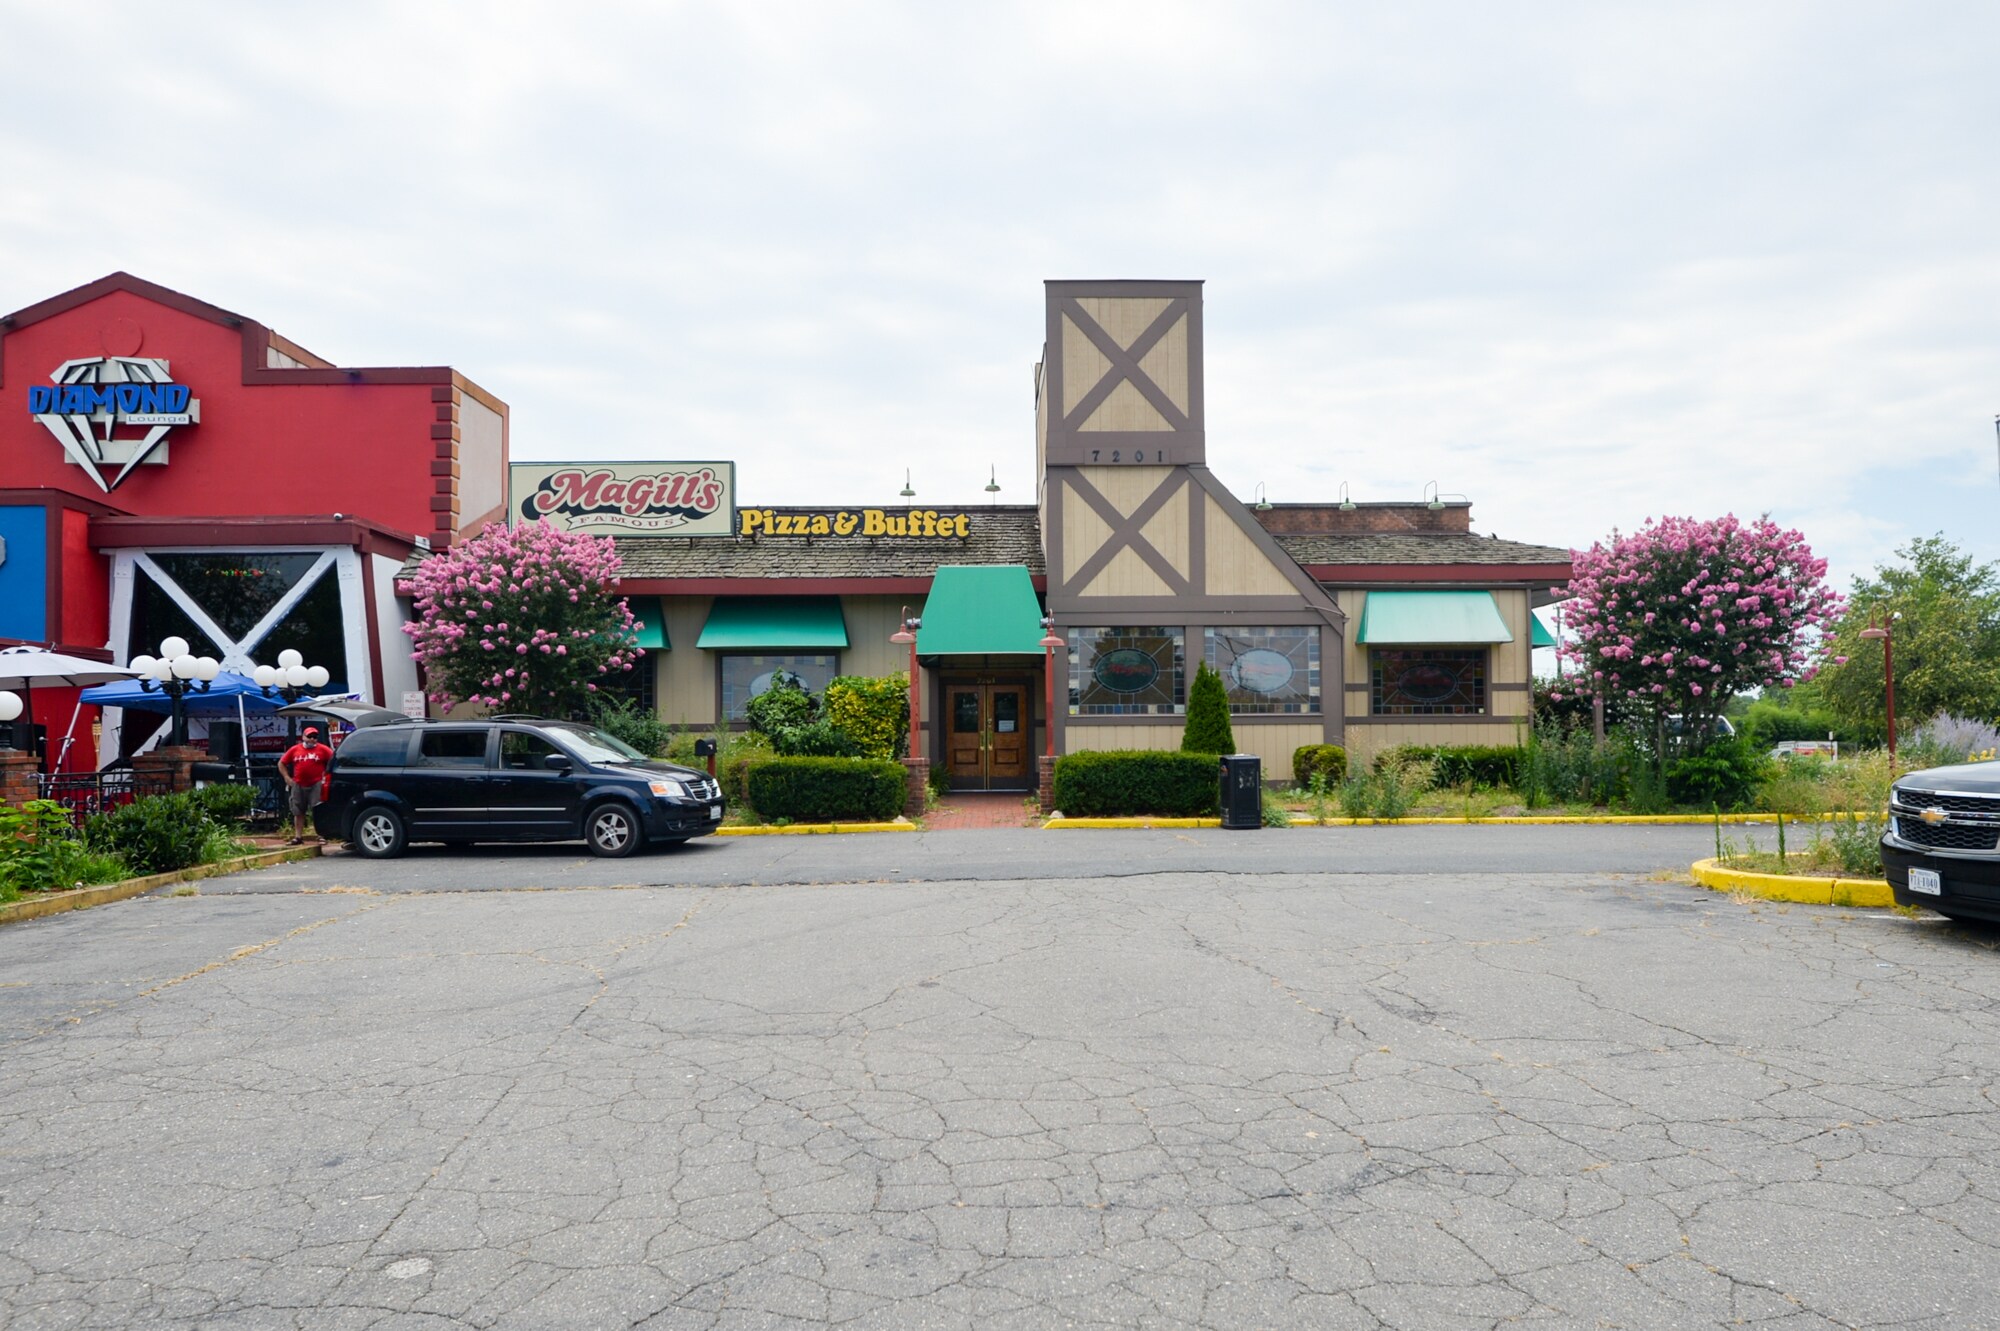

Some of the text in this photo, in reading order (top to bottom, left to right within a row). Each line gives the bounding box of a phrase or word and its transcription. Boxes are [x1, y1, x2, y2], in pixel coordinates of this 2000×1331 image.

[28, 384, 190, 414] DIAMOND
[128, 415, 187, 424] Lounge
[1092, 450, 1162, 463] 7201
[579, 515, 675, 527] FAMOUS
[739, 509, 970, 537] Pizza & Buffet
